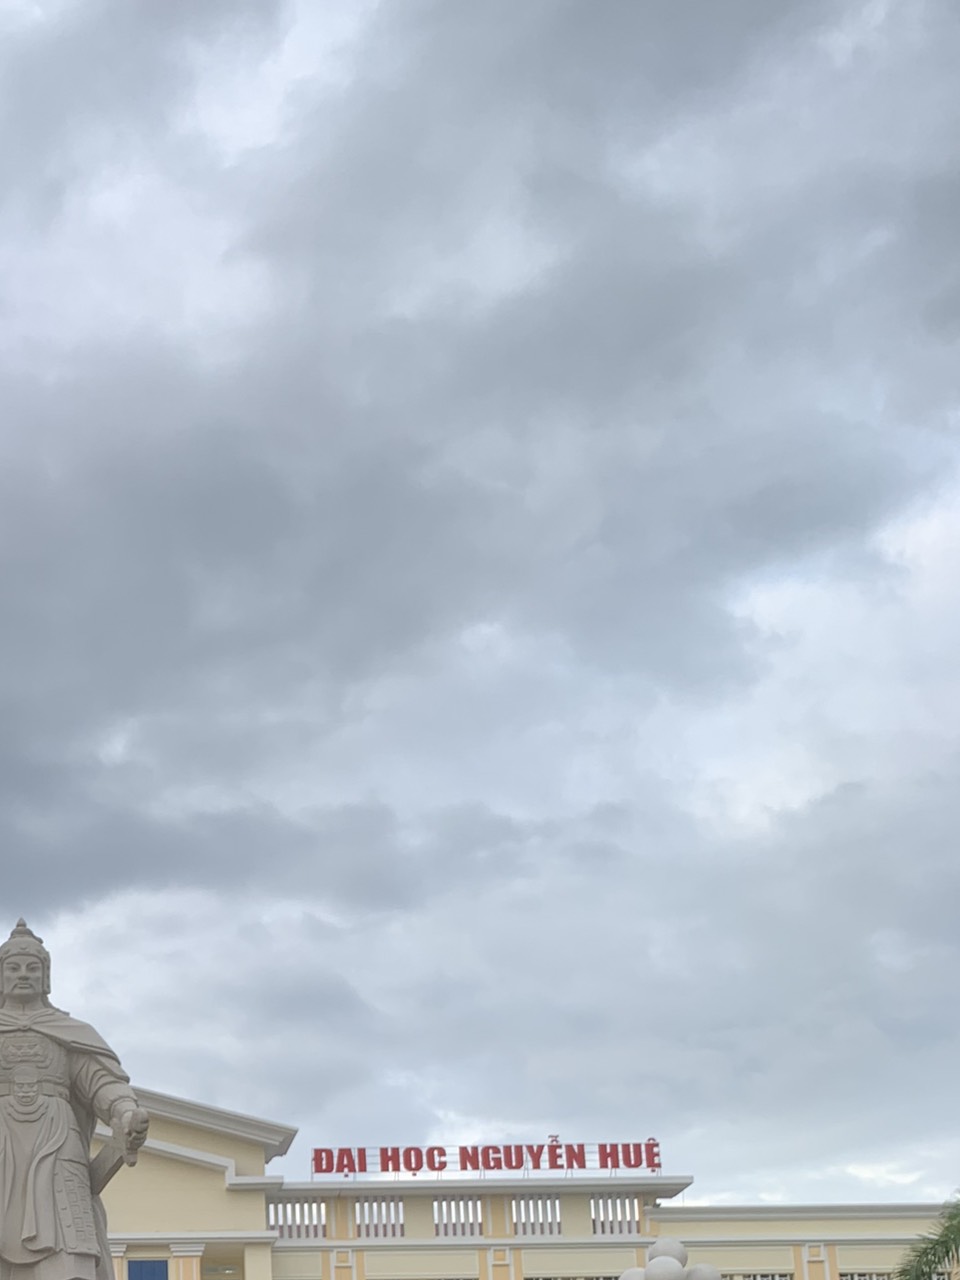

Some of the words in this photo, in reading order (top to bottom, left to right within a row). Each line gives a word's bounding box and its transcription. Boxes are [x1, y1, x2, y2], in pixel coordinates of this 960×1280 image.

[312, 1147, 367, 1177] ĐẠI
[380, 1146, 447, 1176] HỌC
[459, 1134, 586, 1170] NGUYỄN
[598, 1138, 662, 1172] HUỆ
